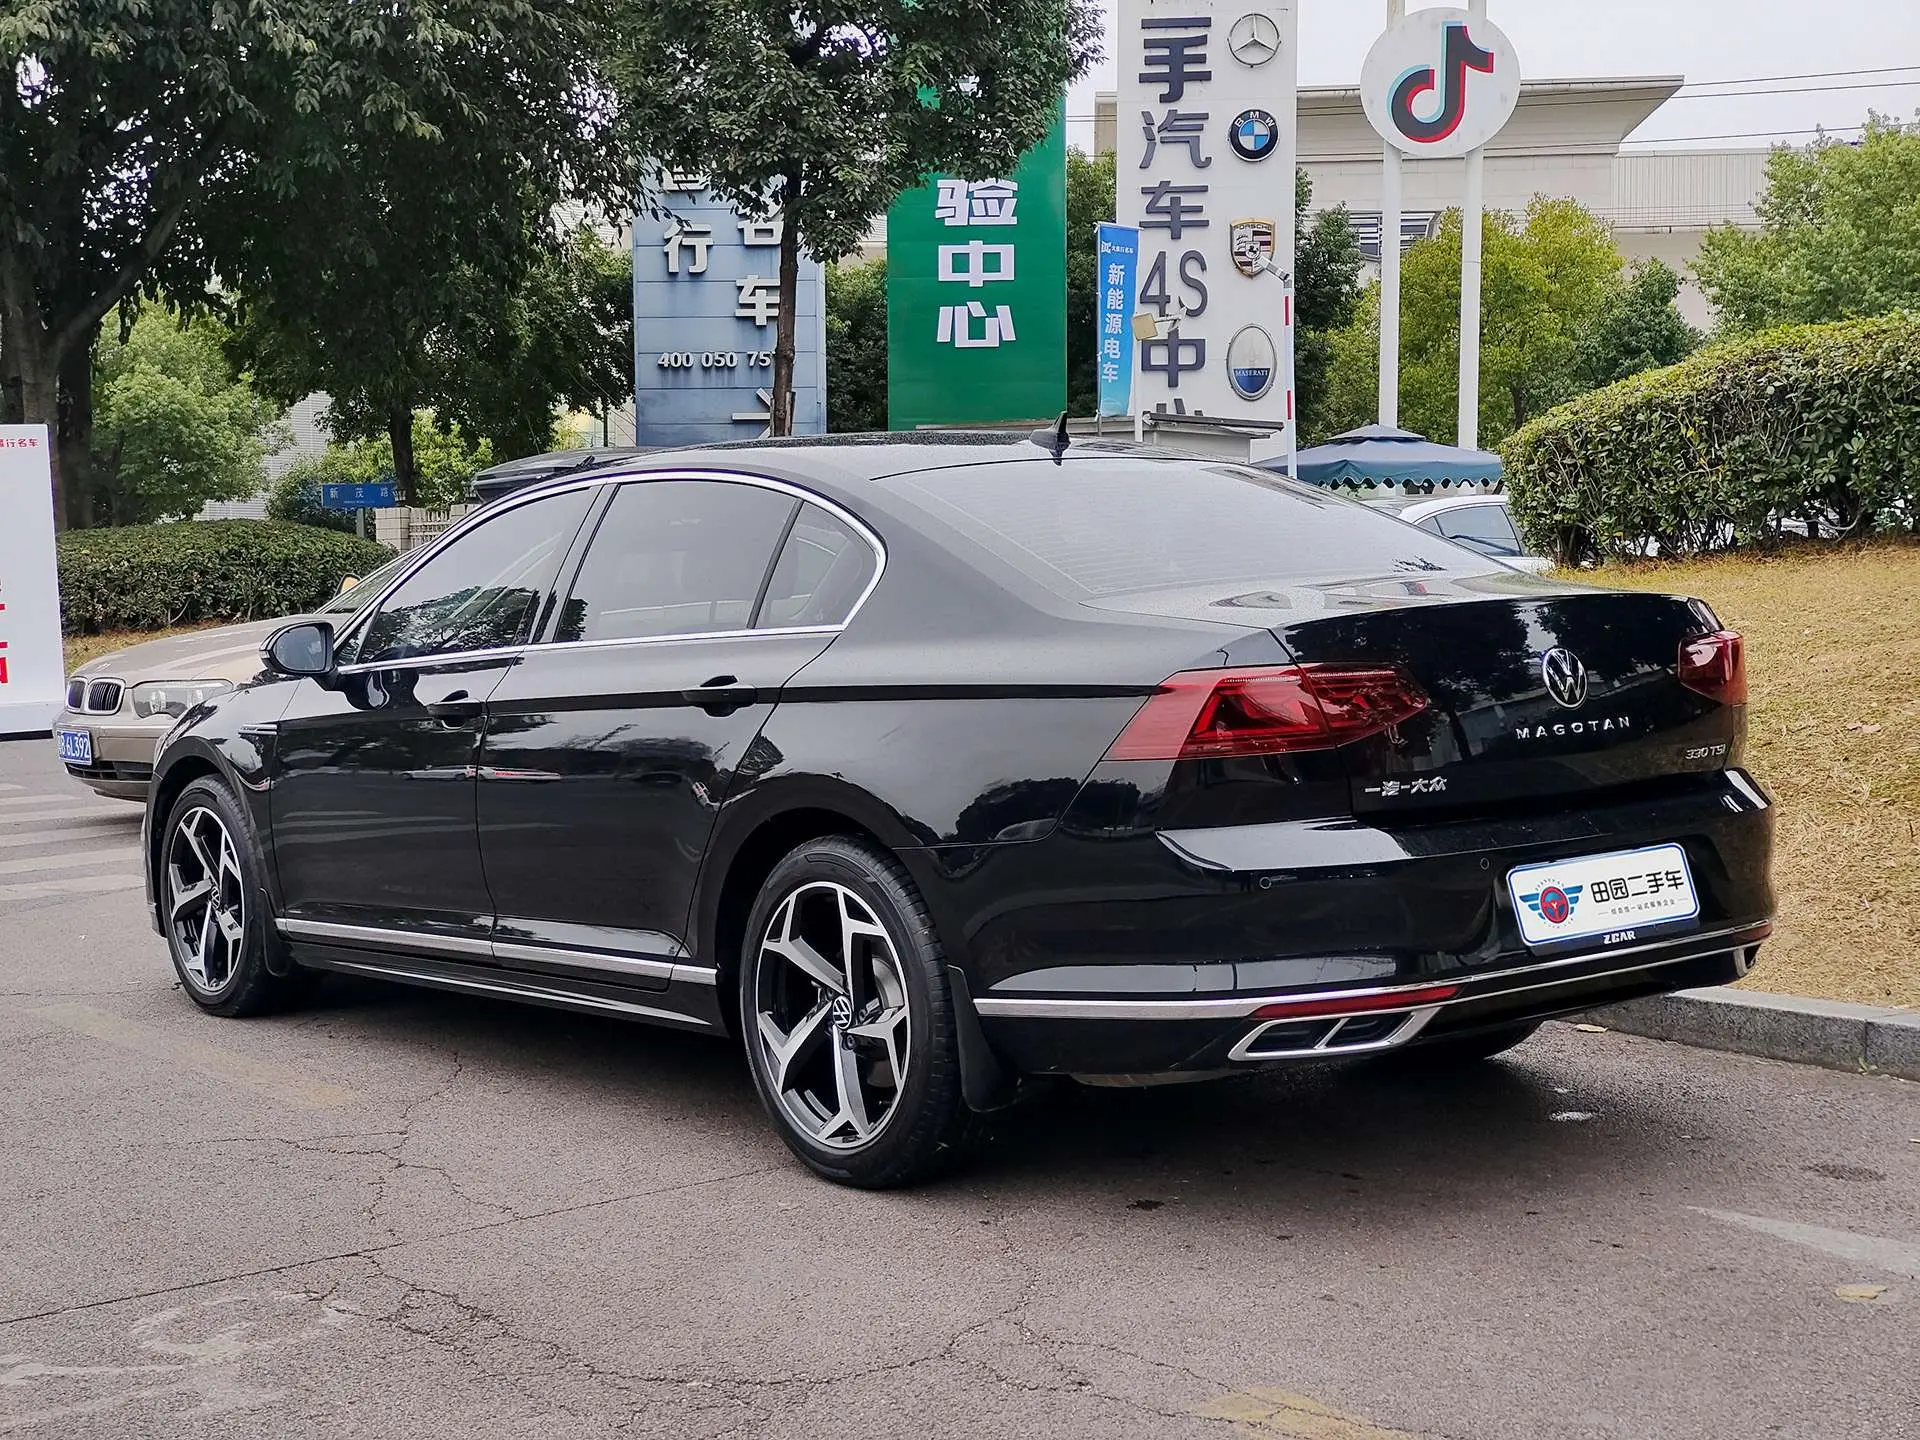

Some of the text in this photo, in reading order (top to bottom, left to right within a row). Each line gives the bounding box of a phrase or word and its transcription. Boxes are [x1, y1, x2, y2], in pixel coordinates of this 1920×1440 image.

[1101, 263, 1126, 383] 新能源电车
[657, 351, 776, 368] 400 050 75
[1235, 369, 1268, 377] MASERATI
[1516, 716, 1631, 740] MAGOTAN
[1590, 870, 1685, 903] 田园二手车
